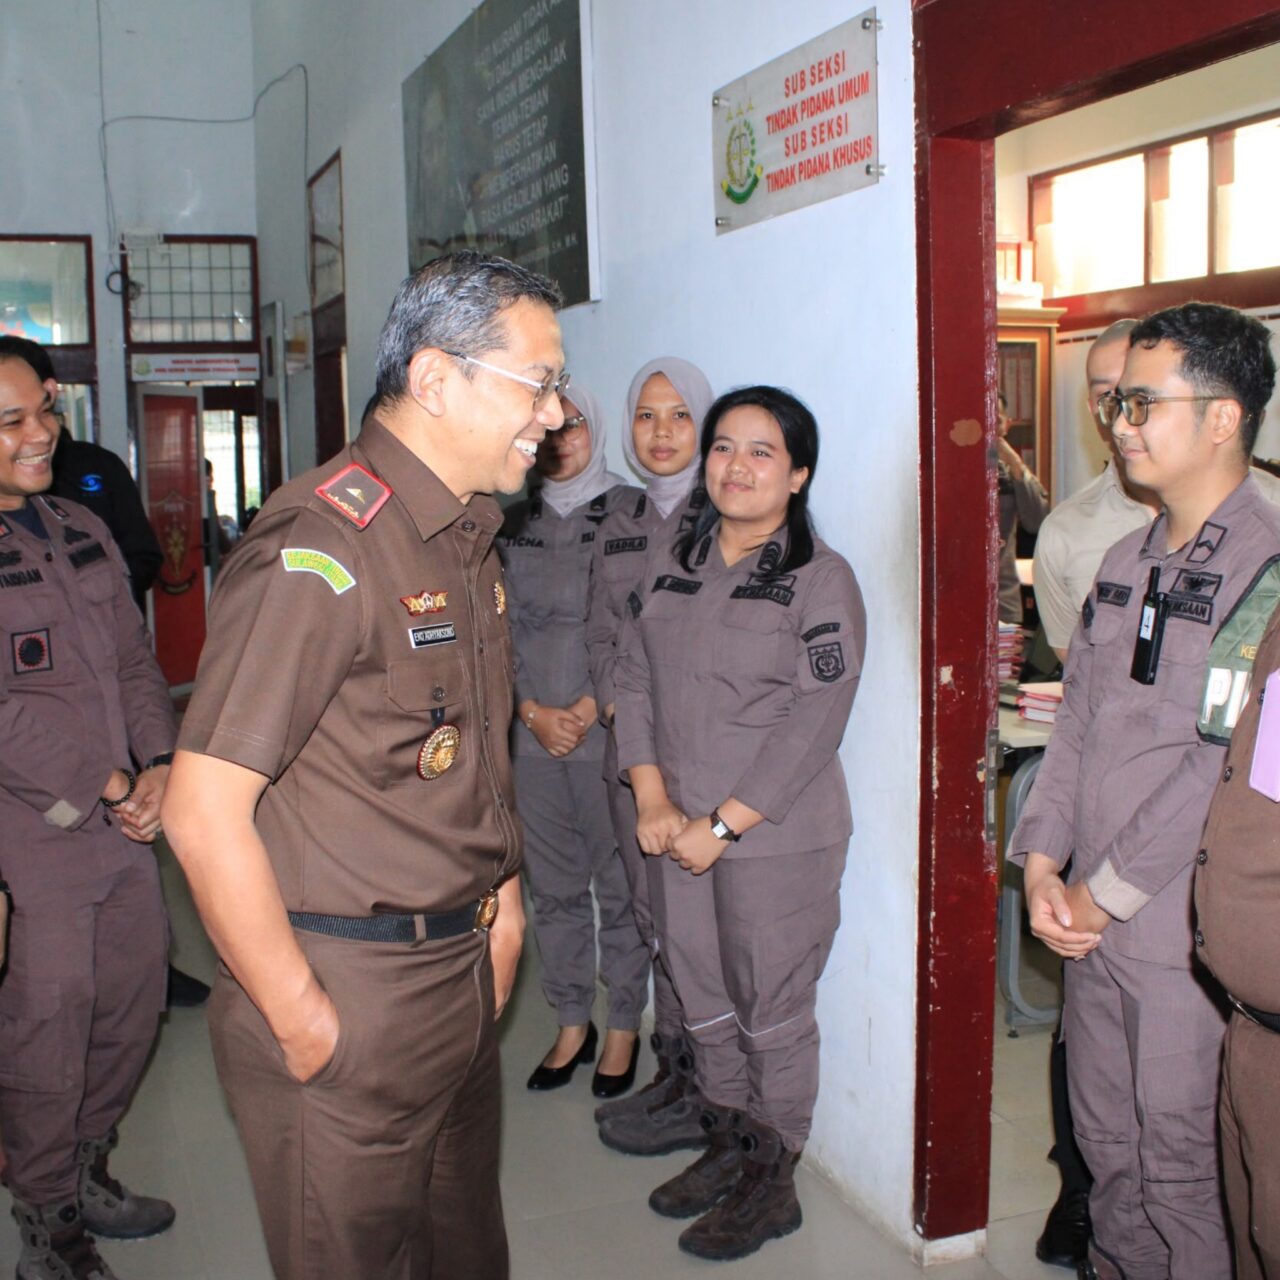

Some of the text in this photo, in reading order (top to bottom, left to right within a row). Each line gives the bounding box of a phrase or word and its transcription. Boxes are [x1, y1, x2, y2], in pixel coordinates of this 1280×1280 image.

[784, 50, 846, 98] SUB SEKSI
[766, 71, 870, 135] TINDAK PIDANA UMUM
[785, 113, 849, 157] SUB SEKSI
[544, 164, 568, 192] YANG
[766, 135, 872, 193] TINDAK PIDANA KHUSUS
